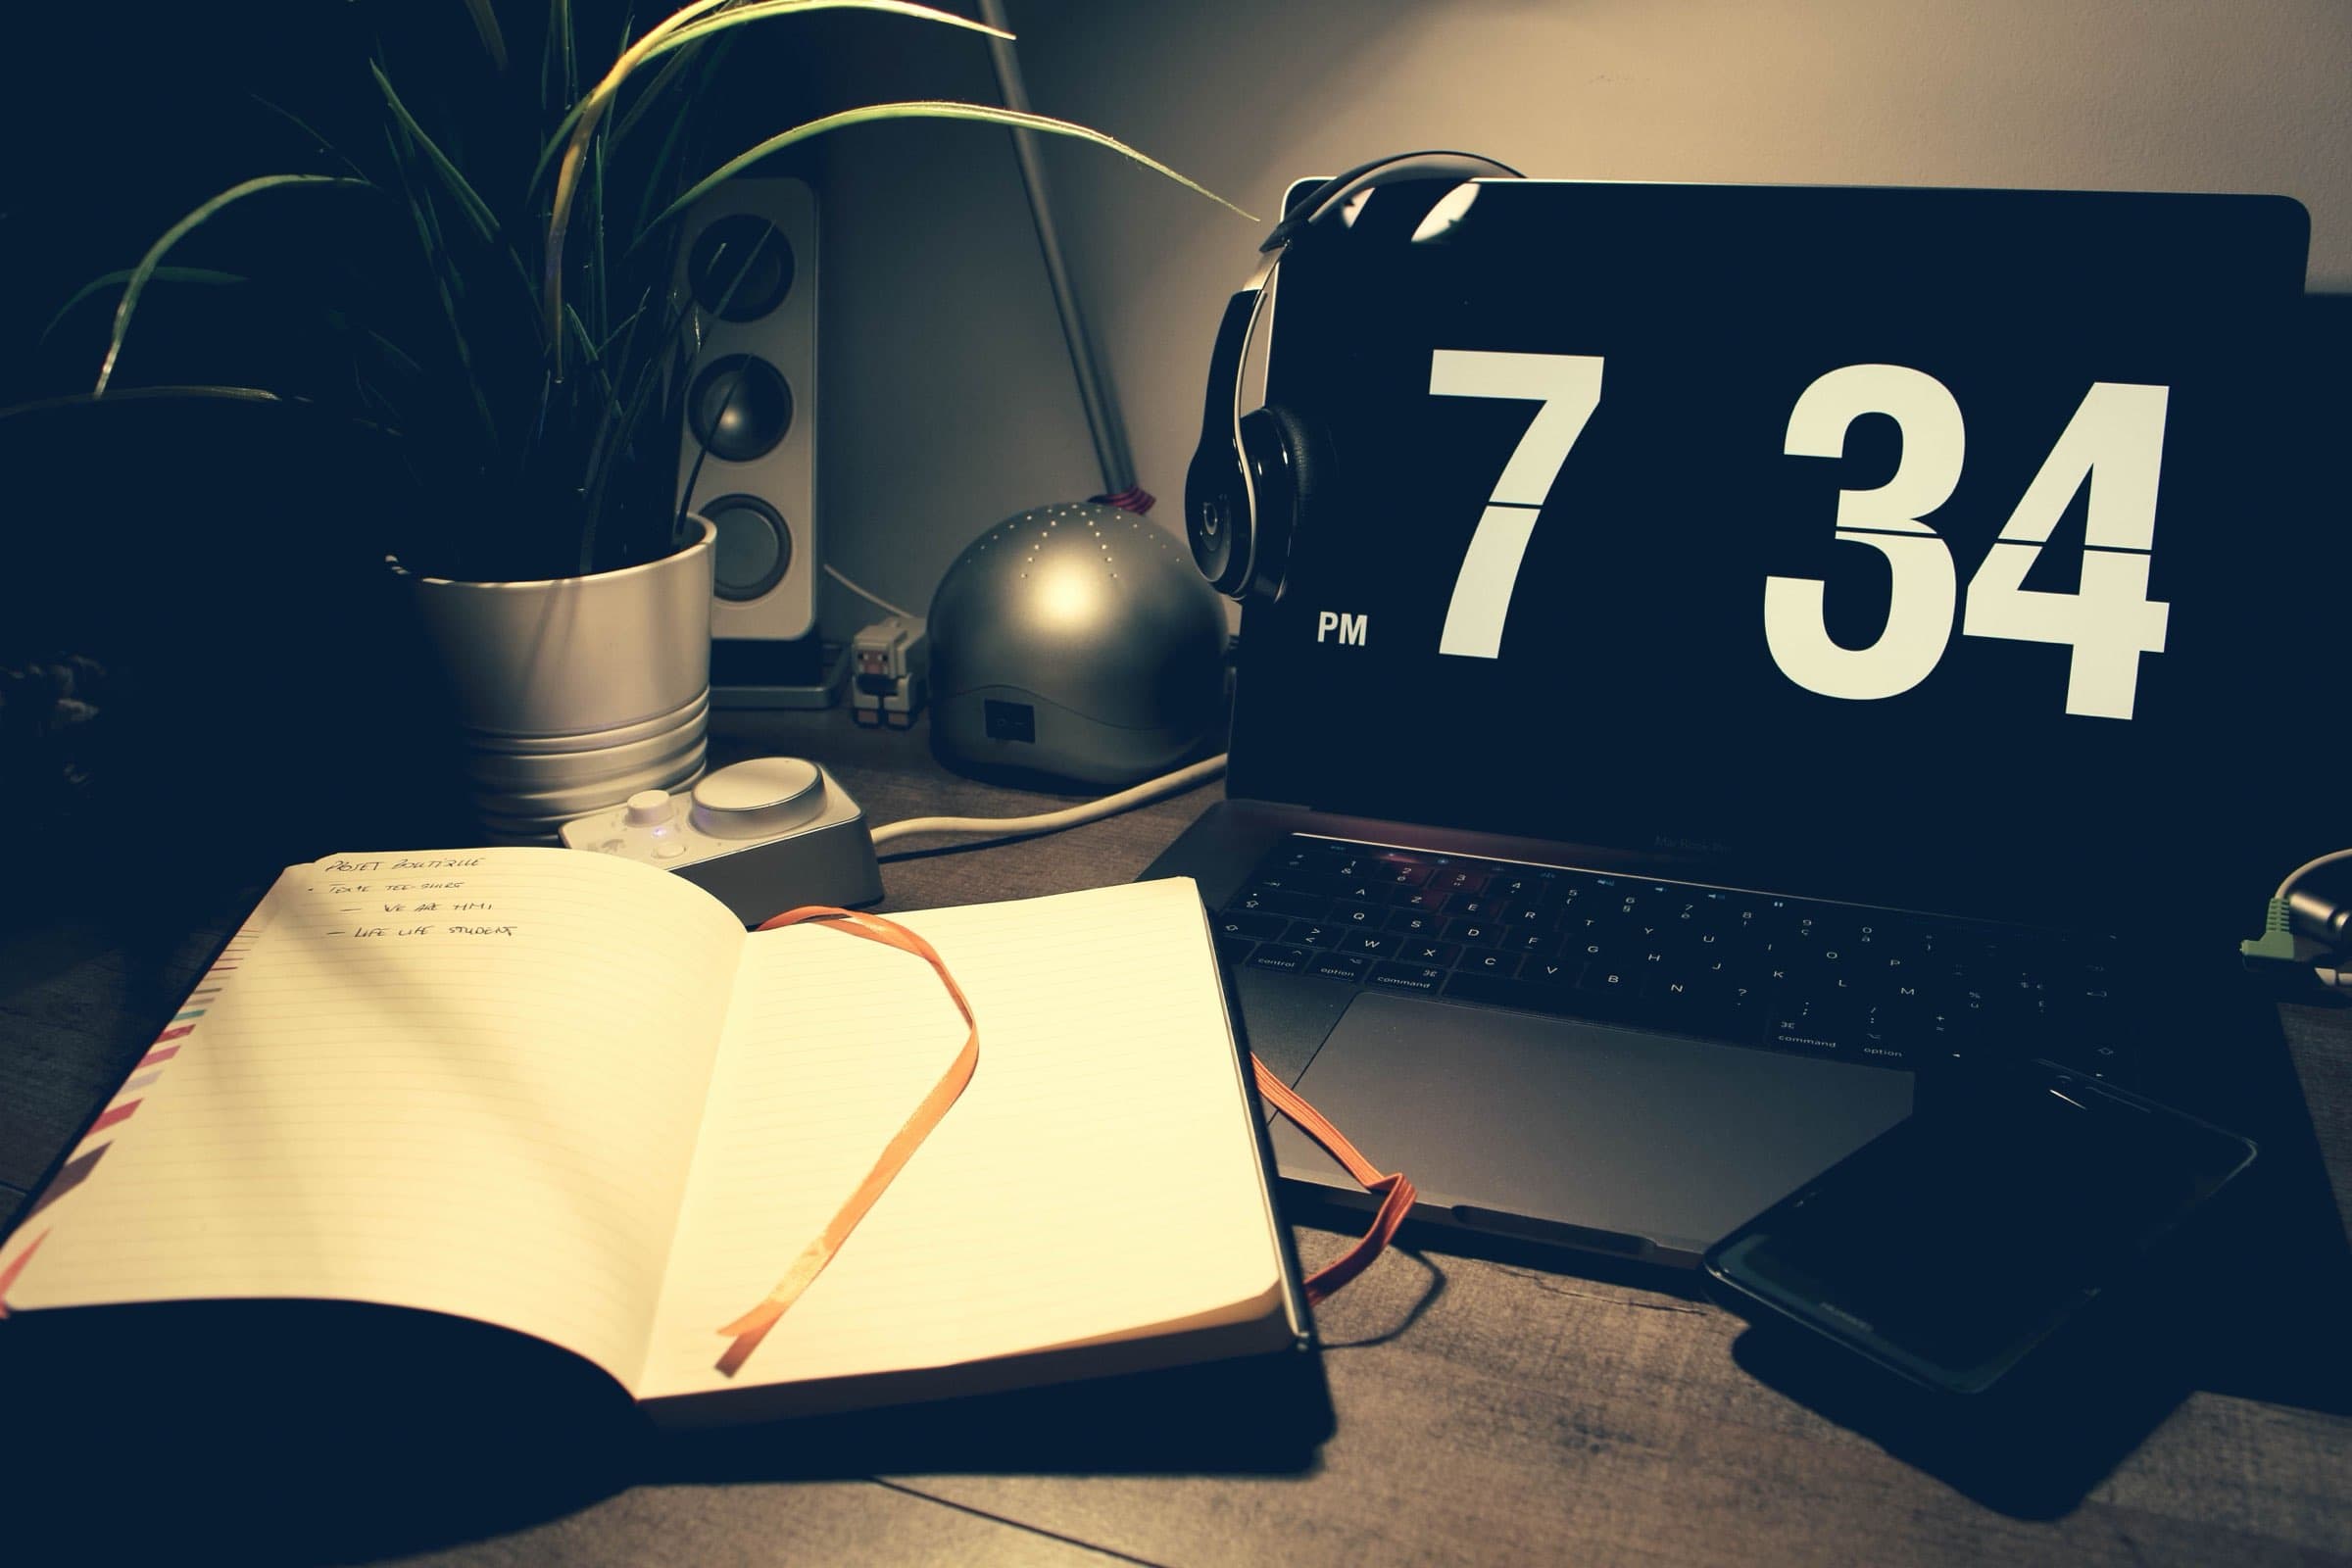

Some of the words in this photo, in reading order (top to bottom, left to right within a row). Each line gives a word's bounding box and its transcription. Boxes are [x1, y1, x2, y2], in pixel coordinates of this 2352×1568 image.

[1429, 349, 1605, 660] 7
[1764, 363, 2171, 720] 34
[1317, 611, 1369, 647] PM
[1352, 911, 1365, 921] Q
[1410, 919, 1422, 929] S
[1467, 928, 1480, 937] D
[1528, 936, 1540, 945] F
[1587, 945, 1599, 954] G
[1647, 953, 1661, 962] H
[1773, 970, 1785, 979] K
[1900, 987, 1915, 996] M
[1355, 888, 1366, 897] A
[1467, 903, 1479, 911] E
[1524, 910, 1537, 920] R
[1826, 951, 1838, 959] O
[1889, 958, 1901, 967] P
[1257, 957, 1296, 968] control
[1320, 967, 1355, 978] option
[1377, 976, 1431, 989] command
[1364, 939, 1381, 949] W
[1422, 949, 1437, 957] X
[1484, 956, 1496, 966] C
[1546, 965, 1559, 975] V
[1607, 974, 1620, 984] B
[1670, 983, 1684, 993] N
[1778, 1035, 1837, 1049] command
[1863, 1048, 1903, 1058] option
